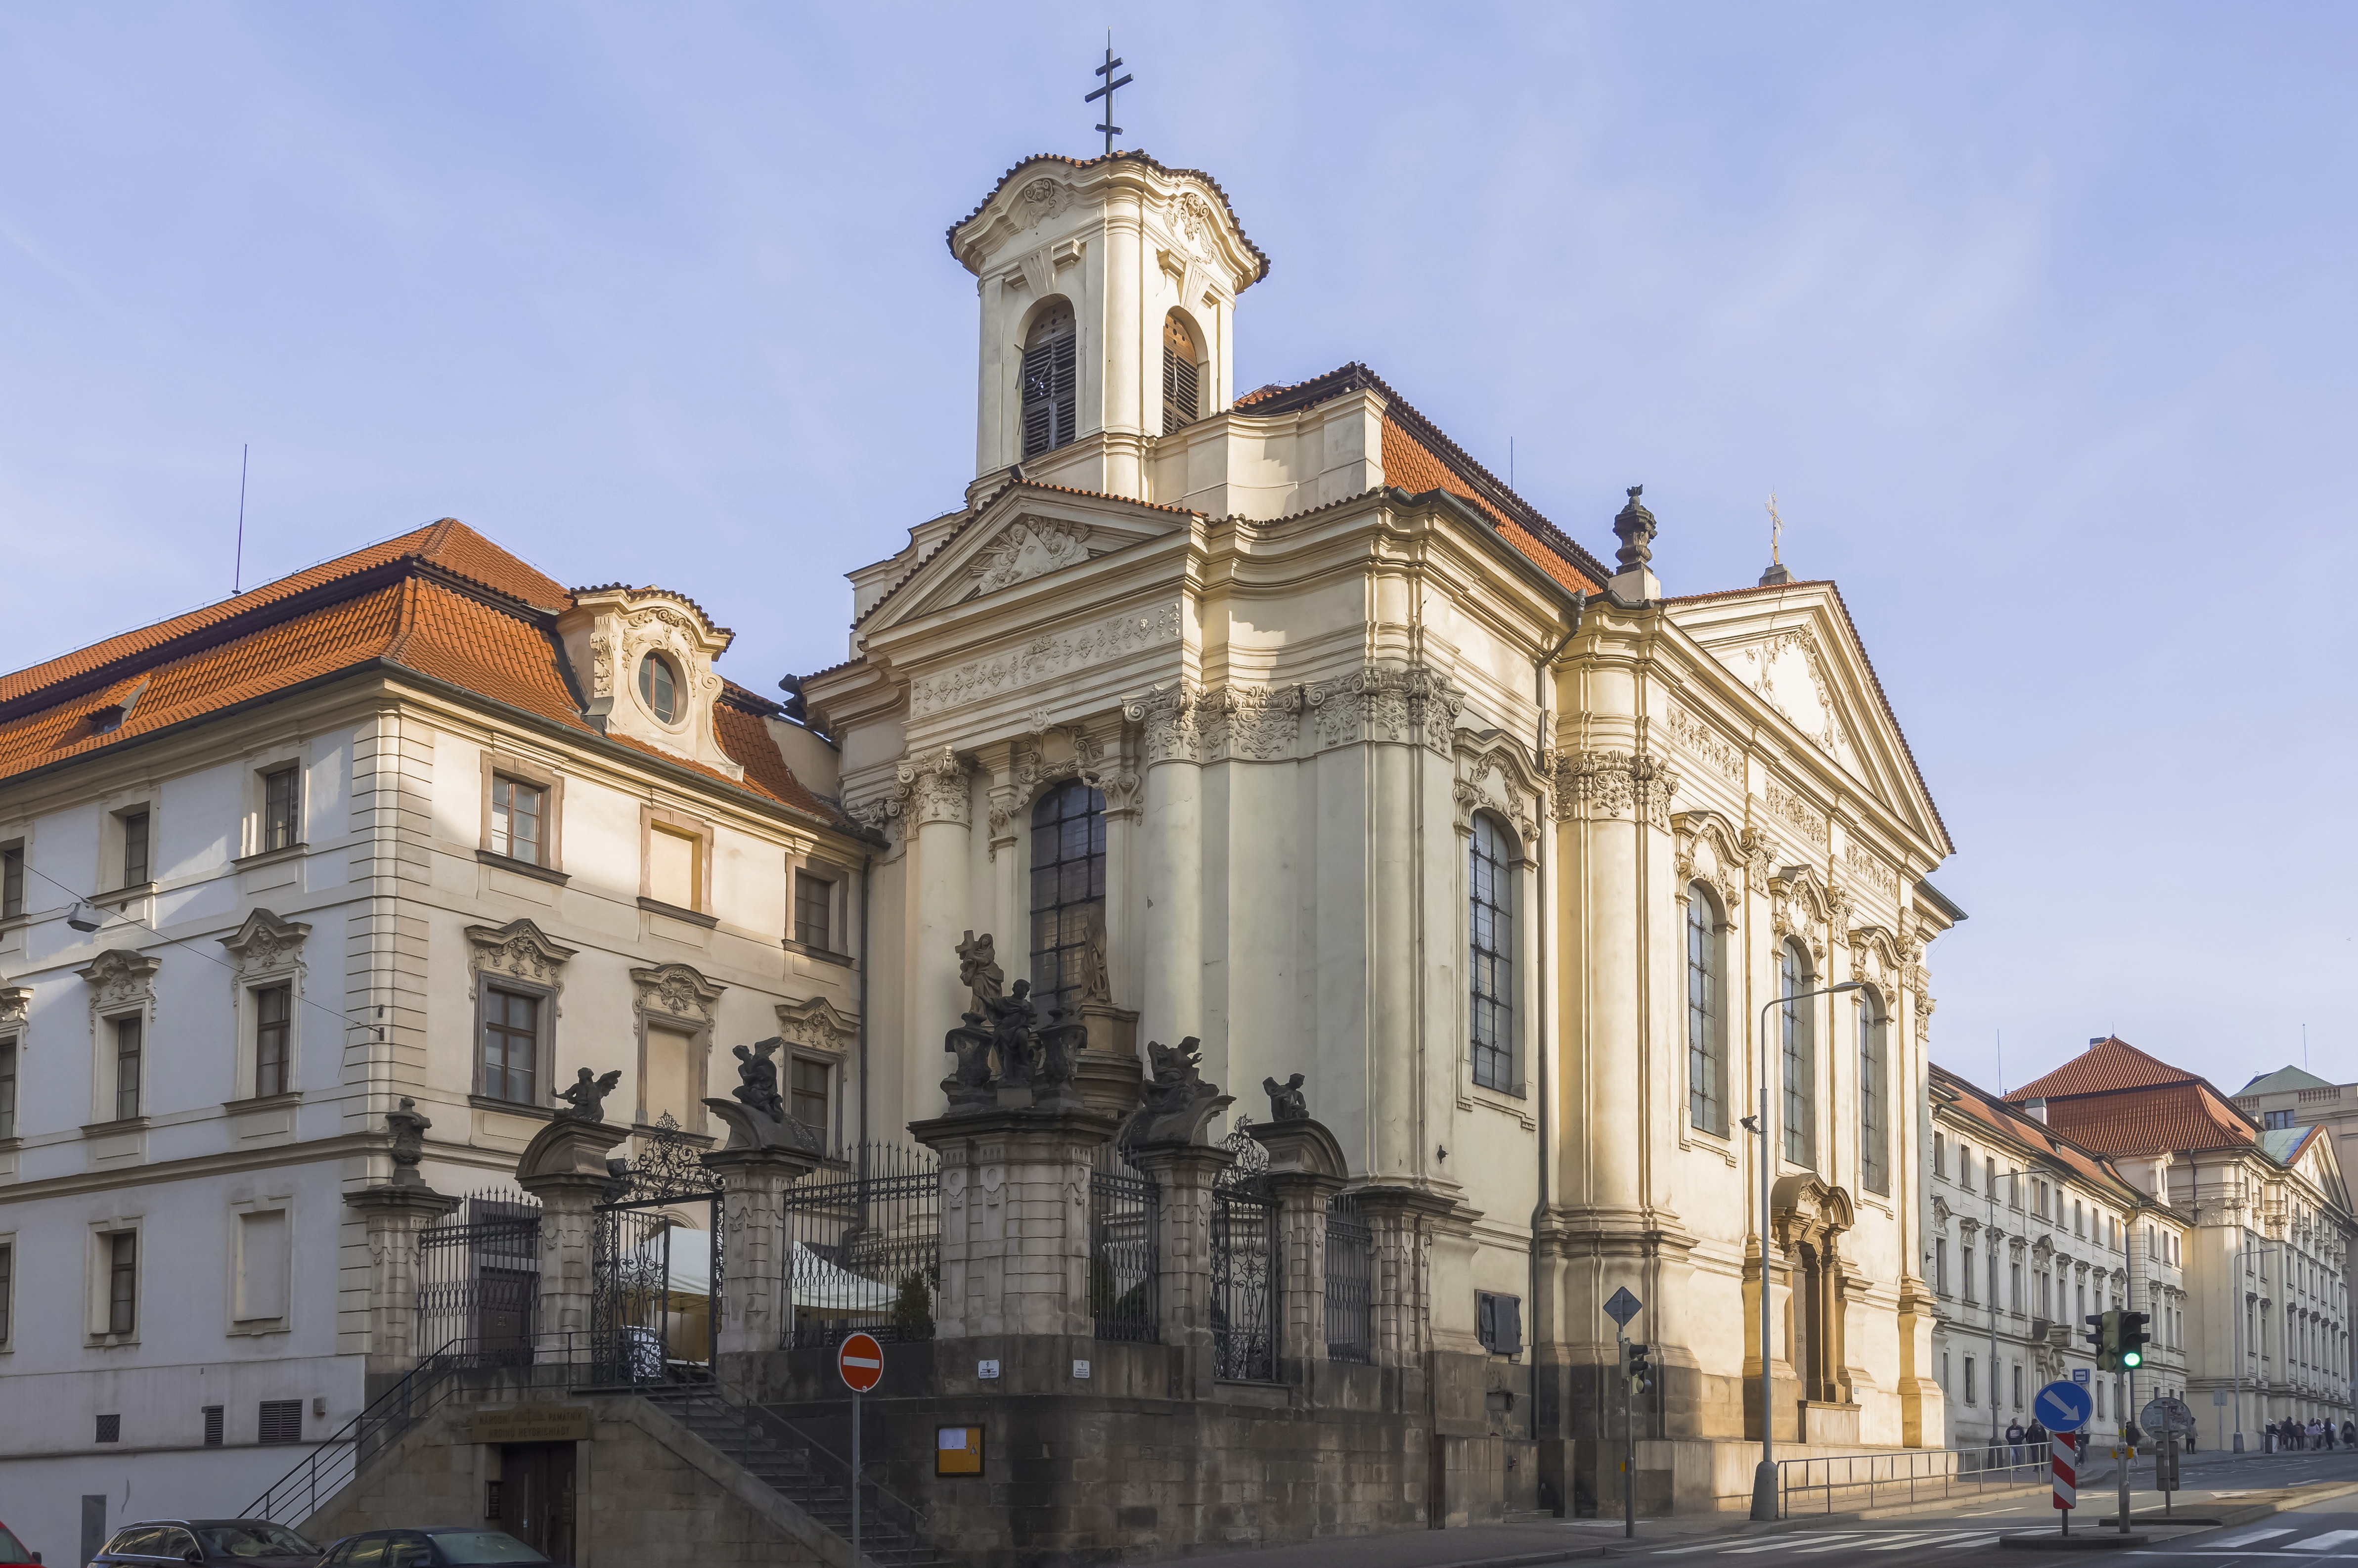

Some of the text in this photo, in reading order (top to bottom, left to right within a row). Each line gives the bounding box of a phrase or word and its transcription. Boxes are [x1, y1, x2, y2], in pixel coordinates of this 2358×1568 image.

[479, 1409, 582, 1425] NÁRODNÍ PAMÁTNÍK
[518, 1424, 570, 1437] HEYDRICHIÁDY
